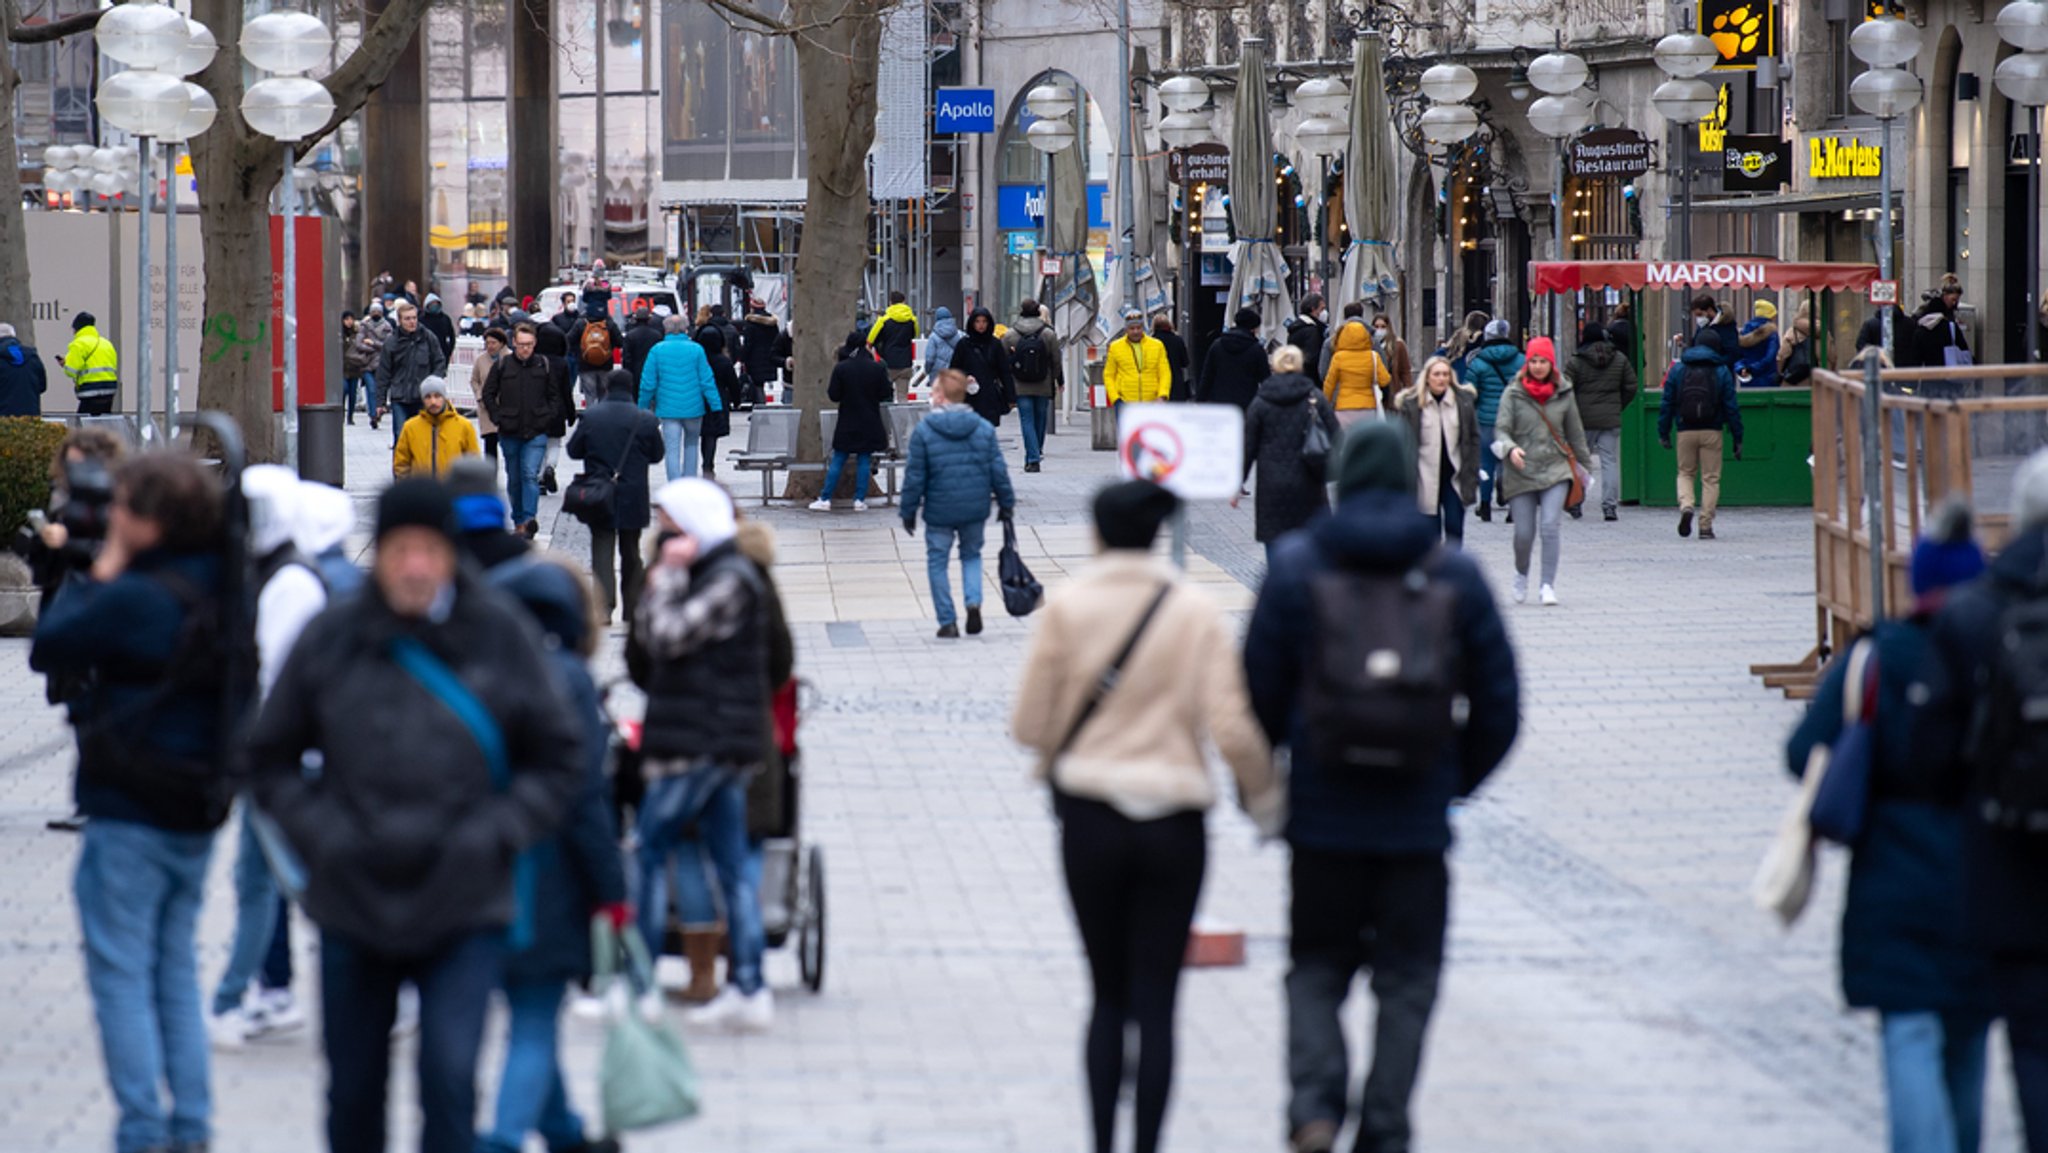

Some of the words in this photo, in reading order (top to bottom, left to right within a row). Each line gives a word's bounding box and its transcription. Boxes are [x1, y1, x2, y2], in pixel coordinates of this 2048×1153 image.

[939, 102, 993, 120] Apollo
[1575, 143, 1646, 158] Augustiner
[1172, 153, 1232, 166] Agustiner
[1575, 158, 1648, 174] Restaurant
[1647, 264, 1765, 283] MARONI
